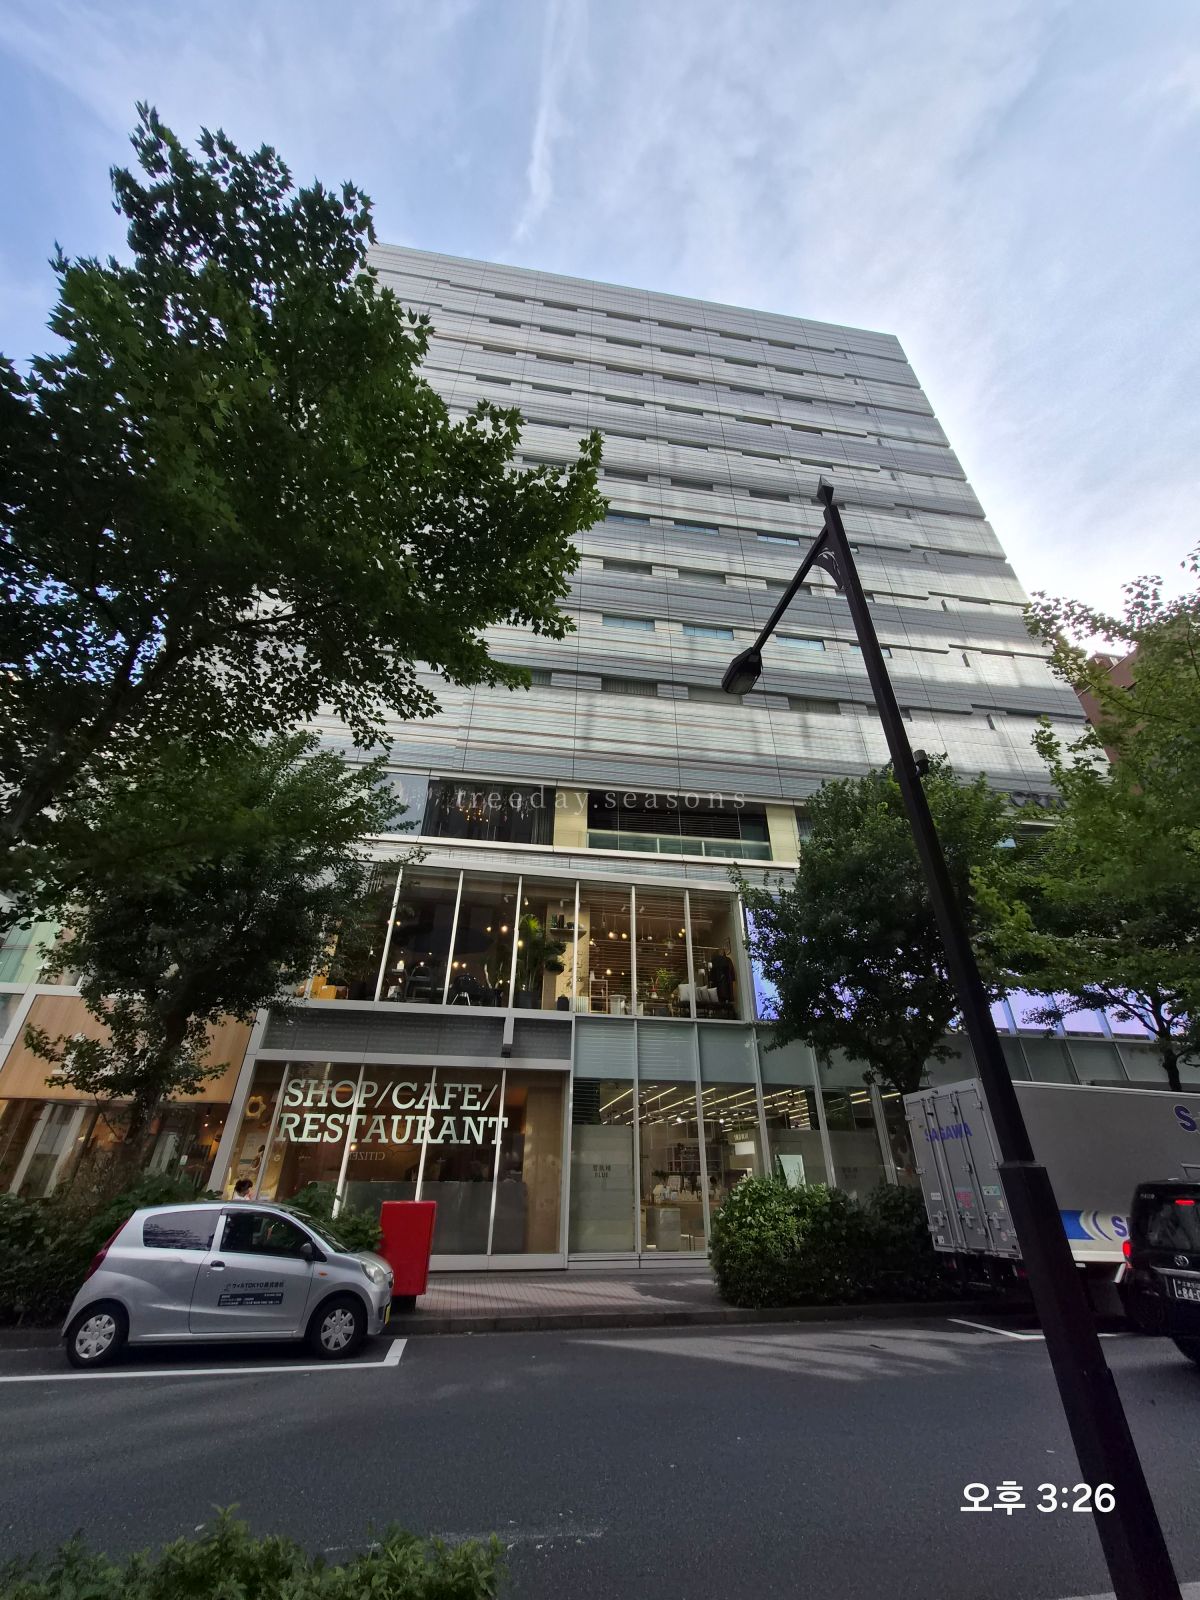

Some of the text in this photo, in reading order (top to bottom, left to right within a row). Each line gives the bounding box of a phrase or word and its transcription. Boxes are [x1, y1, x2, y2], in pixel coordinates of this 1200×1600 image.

[283, 1078, 499, 1112] SHOP/CAFE/
[275, 1112, 509, 1146] RESTAURANT
[1173, 1104, 1200, 1134] S
[1111, 1215, 1128, 1238] S
